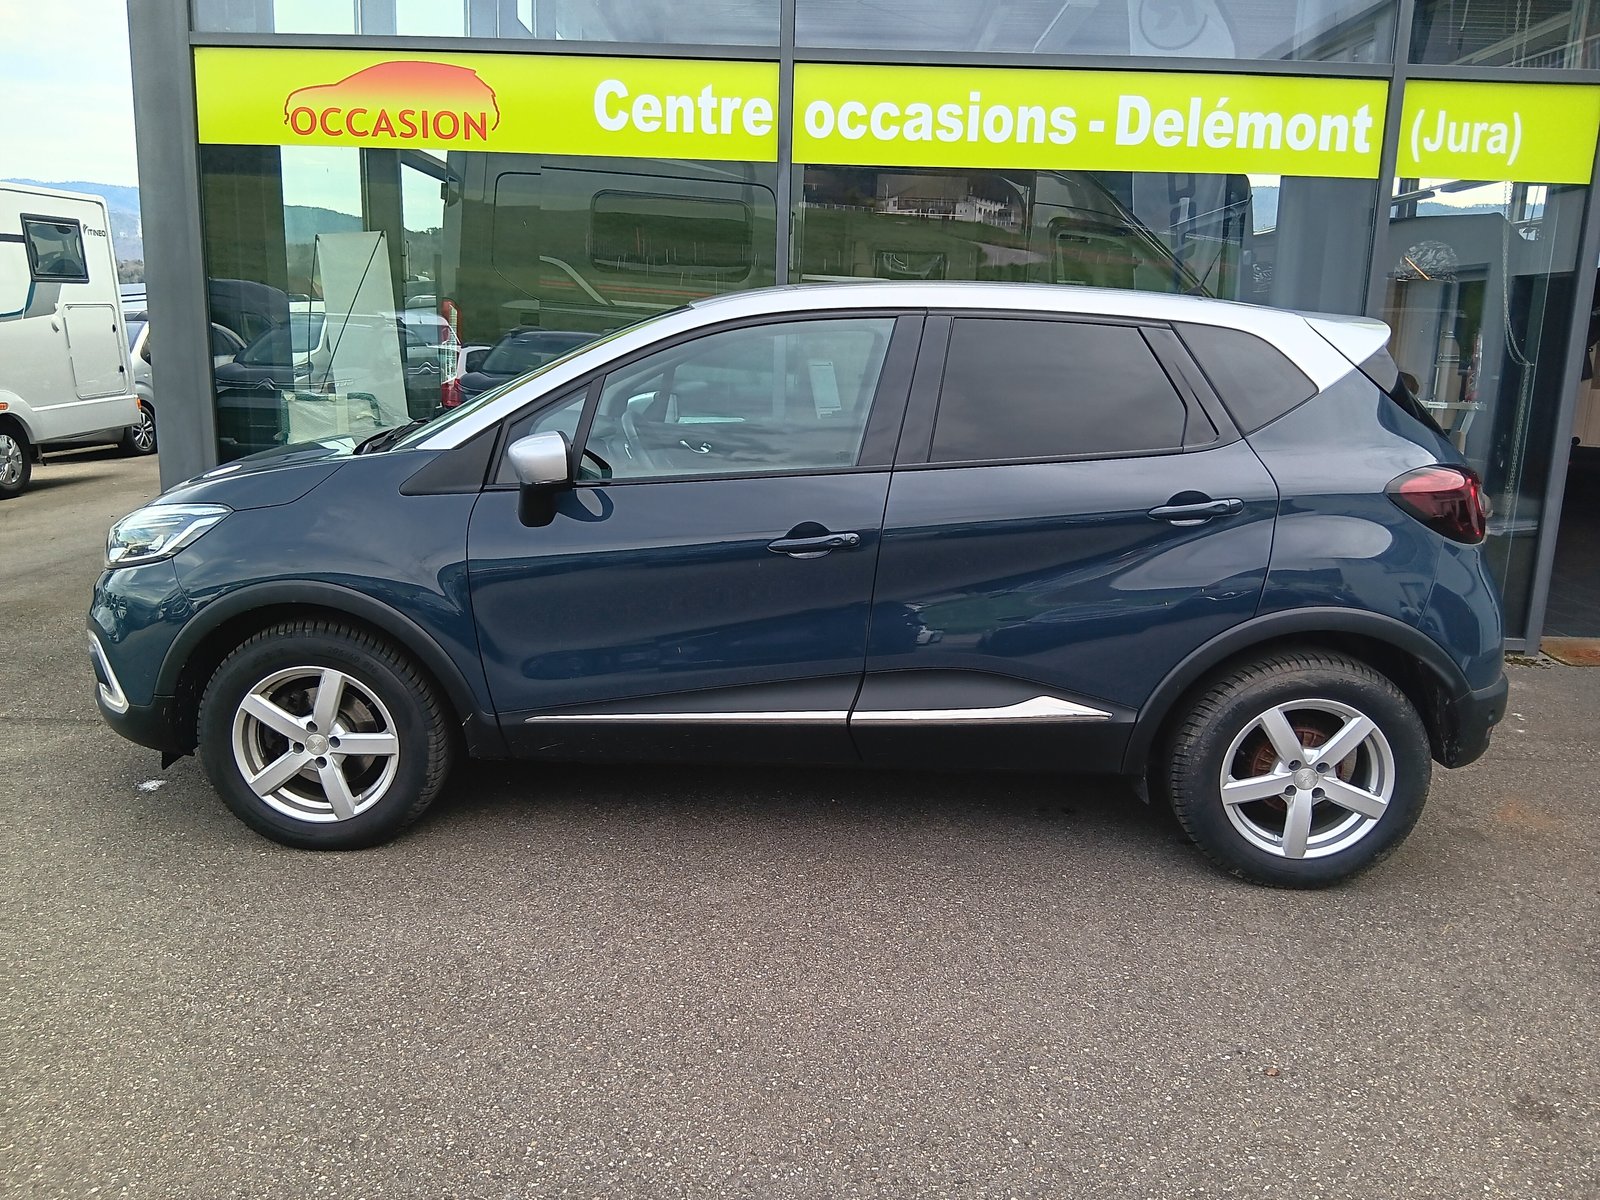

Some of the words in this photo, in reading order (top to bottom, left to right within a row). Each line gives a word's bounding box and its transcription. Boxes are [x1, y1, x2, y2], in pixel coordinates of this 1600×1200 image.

[290, 106, 488, 140] OCCASION
[593, 79, 774, 136] Centre
[804, 91, 1077, 145] occasions
[1088, 119, 1105, 133] -
[1115, 95, 1373, 154] Delémont
[1411, 110, 1522, 166] (Jura)
